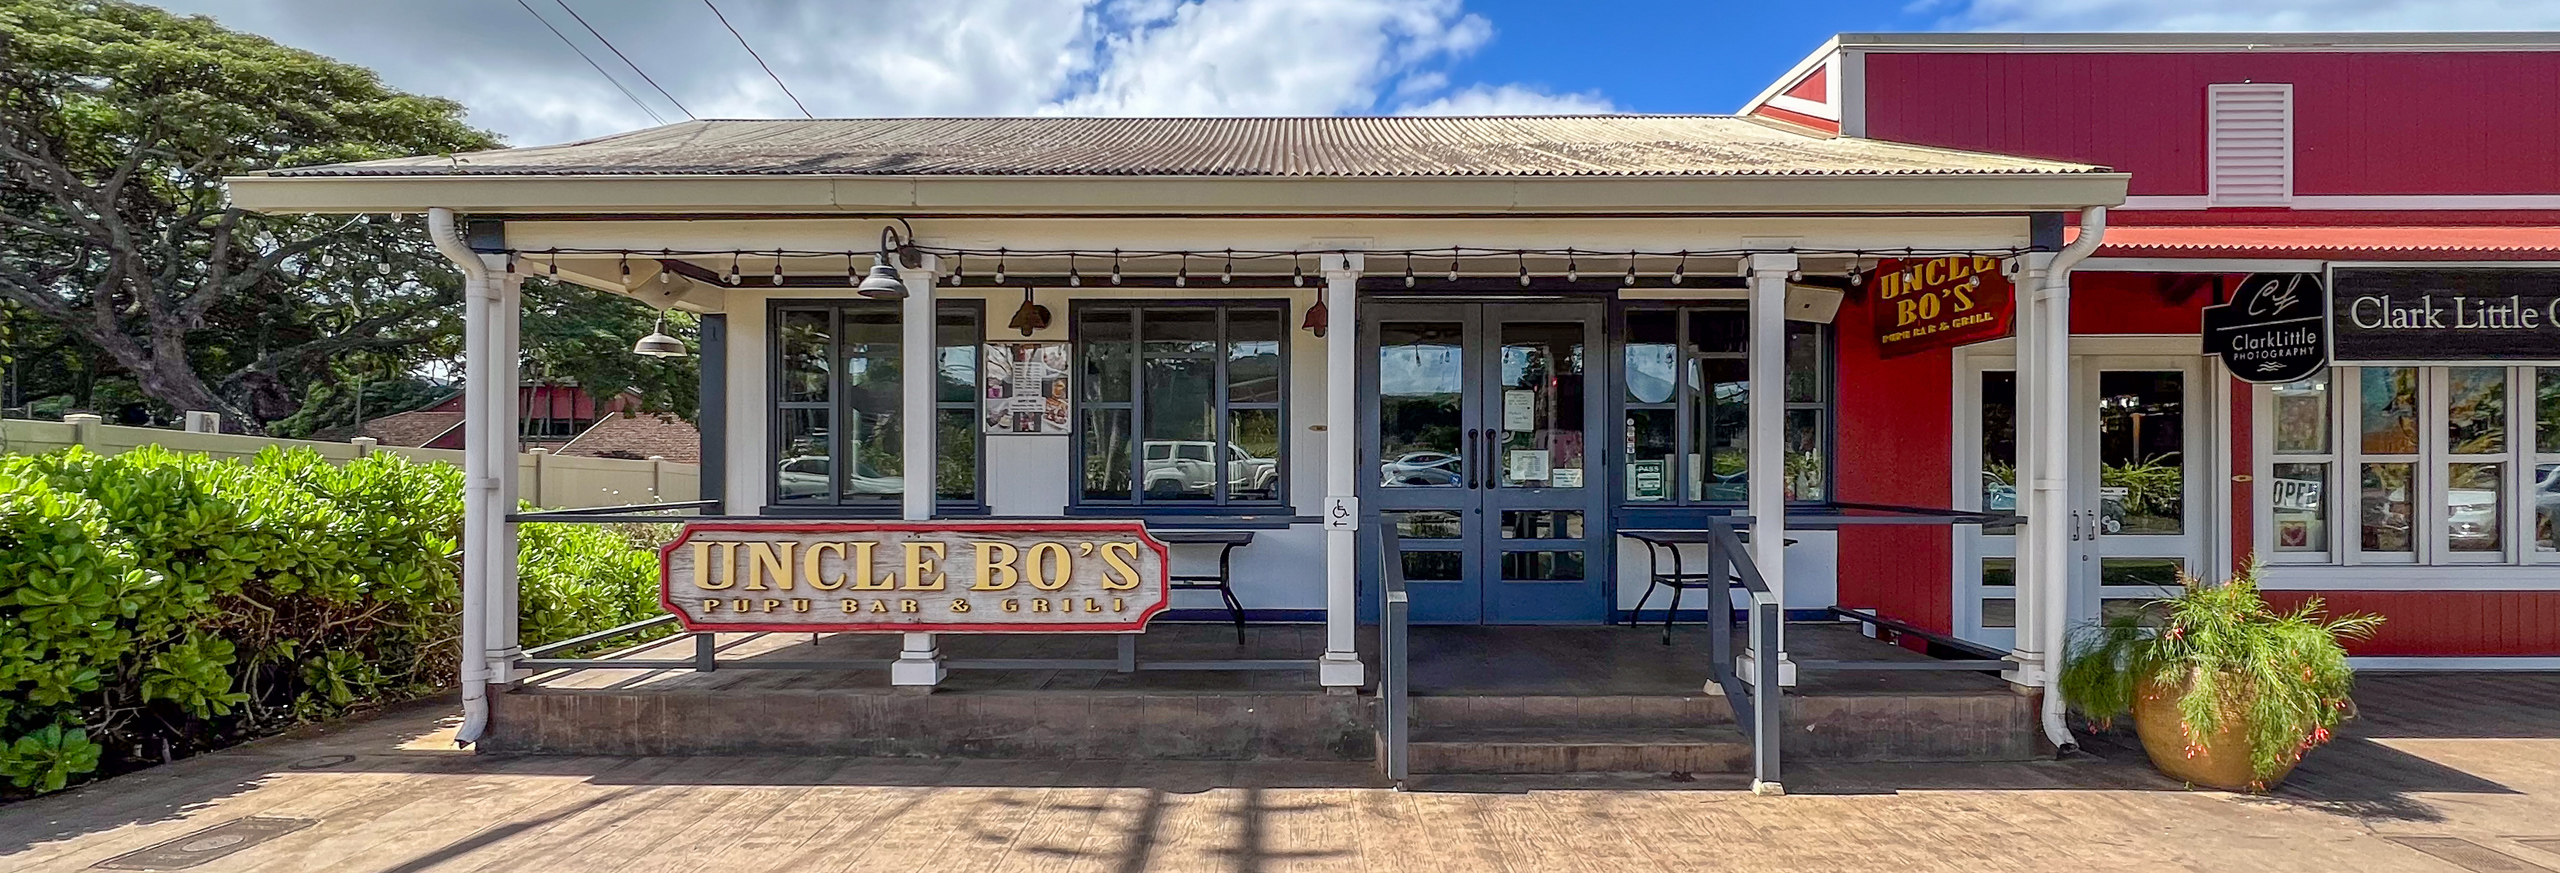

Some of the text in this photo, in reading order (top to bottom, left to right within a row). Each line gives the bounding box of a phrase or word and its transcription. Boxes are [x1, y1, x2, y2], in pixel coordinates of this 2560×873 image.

[1880, 257, 1996, 299] UNCLE
[1896, 282, 1975, 327] BO'S
[2351, 294, 2446, 329] Clark
[2453, 294, 2540, 329] Little
[1882, 312, 1994, 344] PUPU BAR & GRILL
[2232, 327, 2317, 351] ClarkLittle
[2233, 346, 2315, 360] PHOTOGRAPHY
[688, 540, 1140, 591] UNCLE BO'S
[703, 598, 812, 613] PUPU
[841, 598, 919, 613] BAR
[950, 598, 971, 613] &
